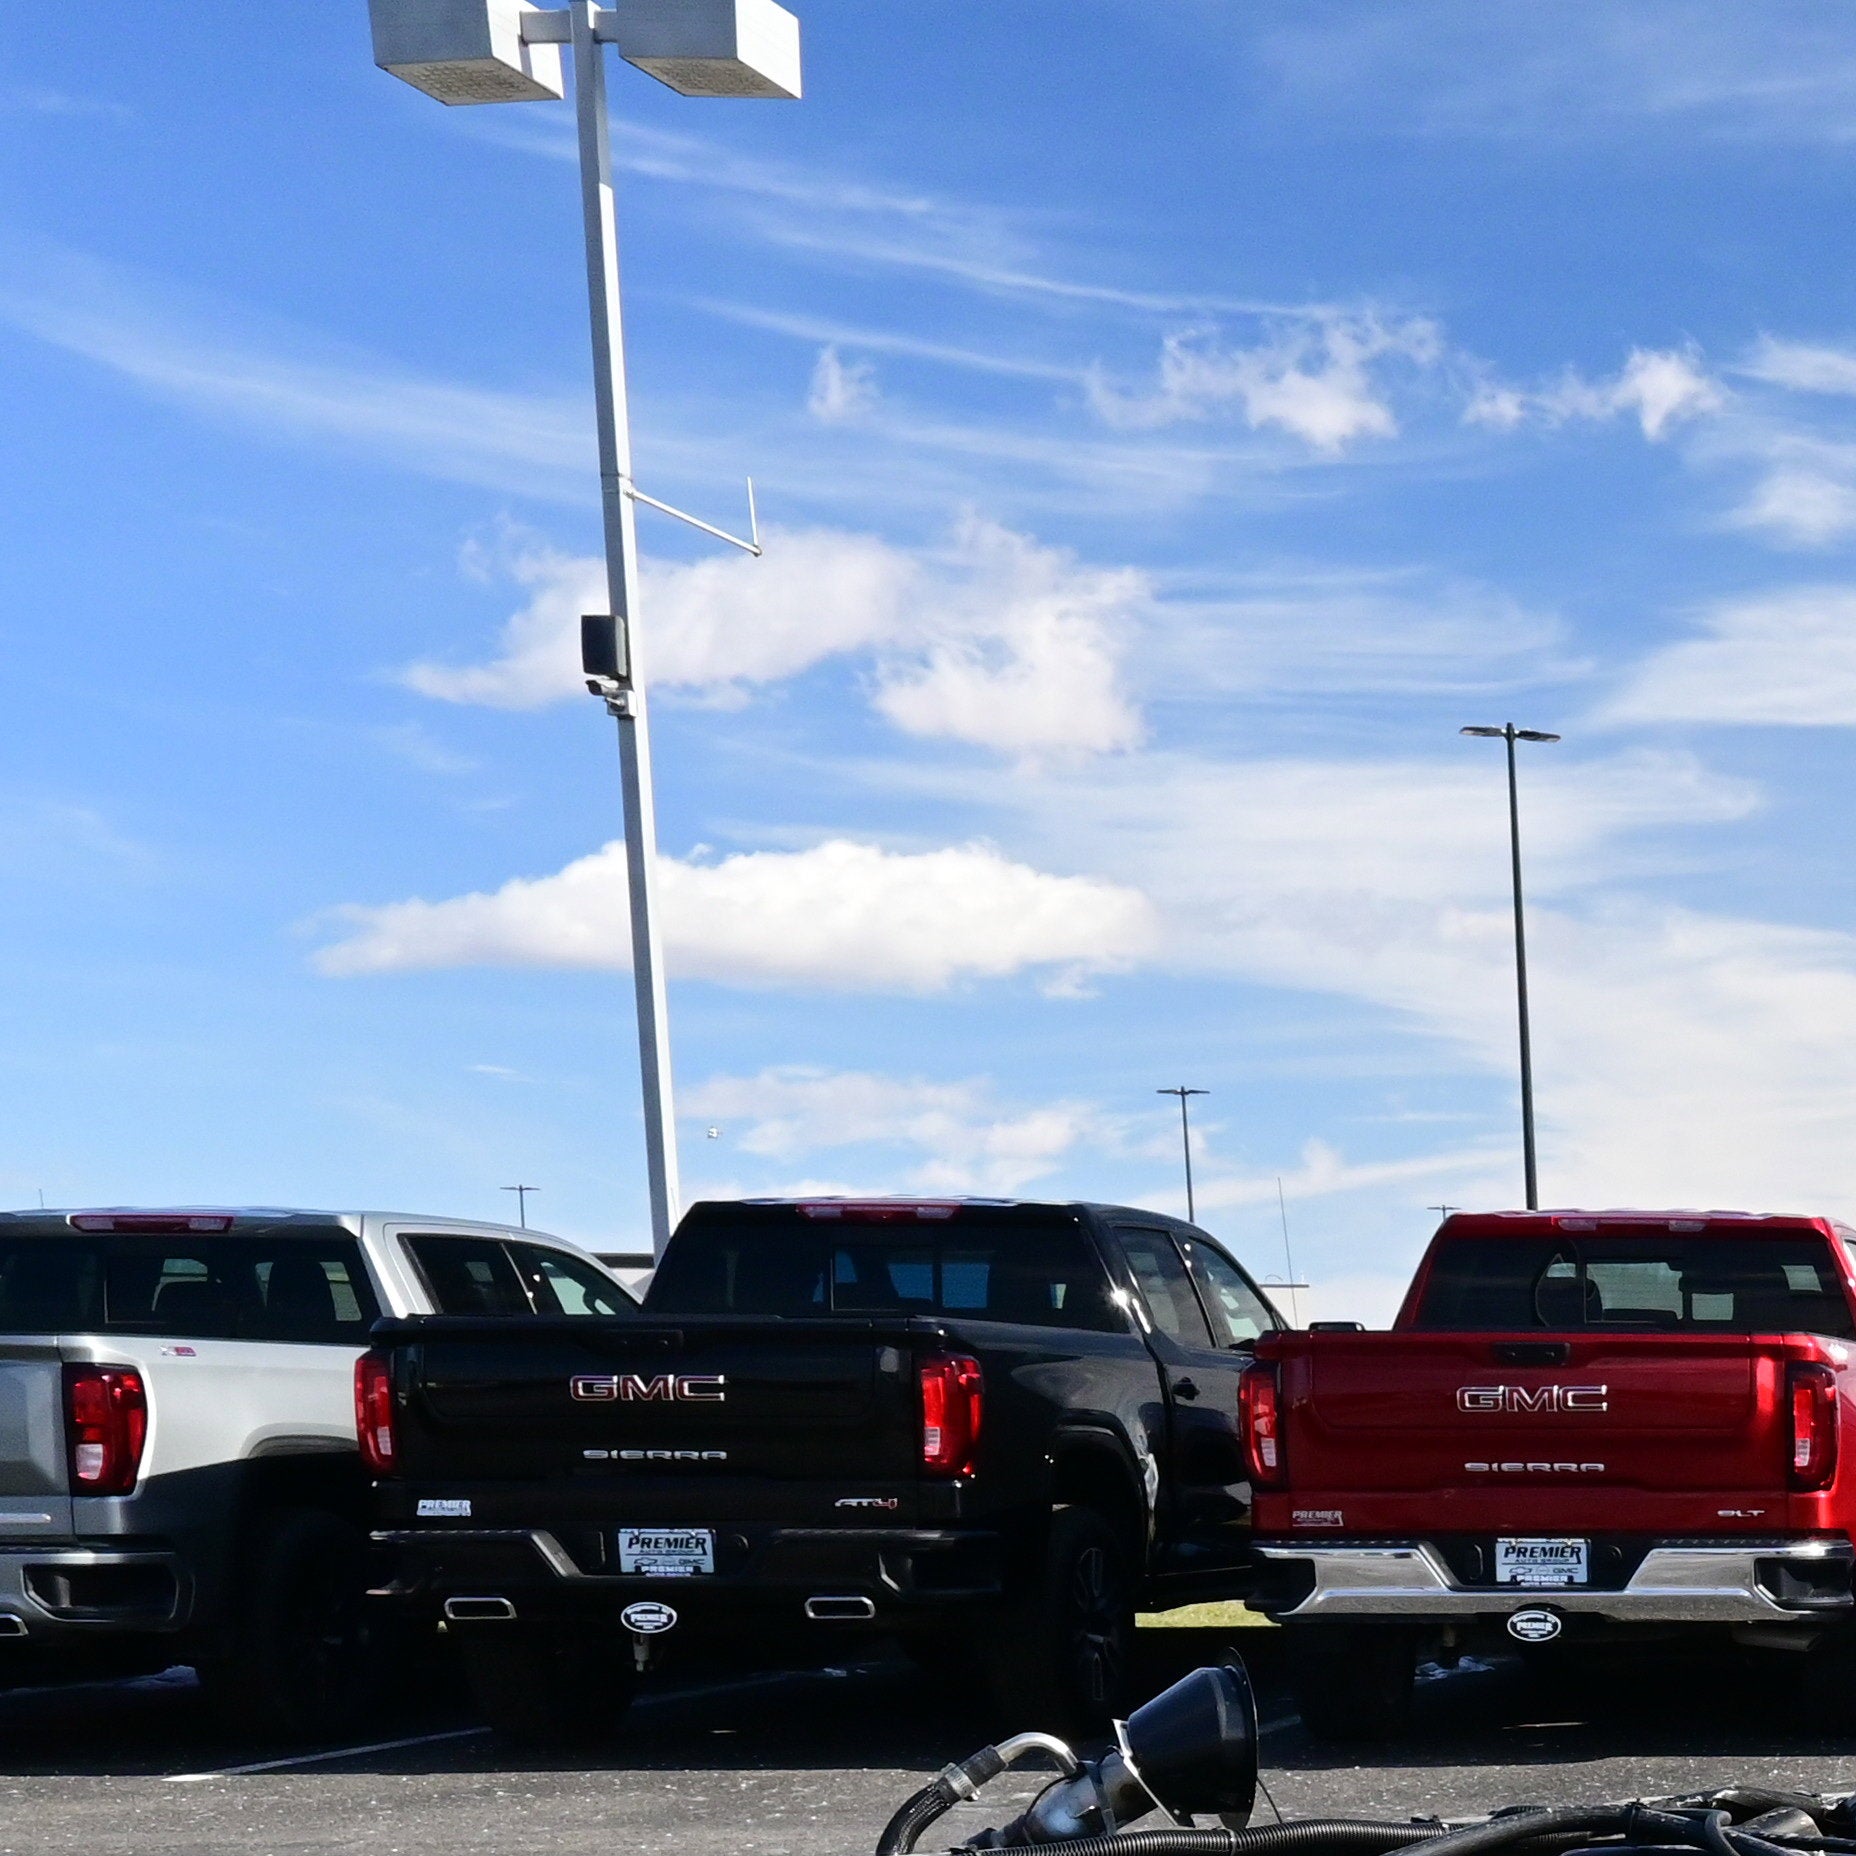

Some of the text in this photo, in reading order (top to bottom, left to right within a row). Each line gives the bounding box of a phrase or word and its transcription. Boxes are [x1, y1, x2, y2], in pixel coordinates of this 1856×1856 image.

[570, 1374, 725, 1401] GMC
[1456, 1384, 1608, 1413] GMC
[583, 1449, 728, 1460] SIERRA
[1464, 1462, 1605, 1472] SIERRA
[834, 1497, 898, 1510] AT4
[627, 1536, 708, 1554] PREMIER
[1503, 1546, 1582, 1563] PREMIER
[1516, 1574, 1568, 1582] PREMIER
